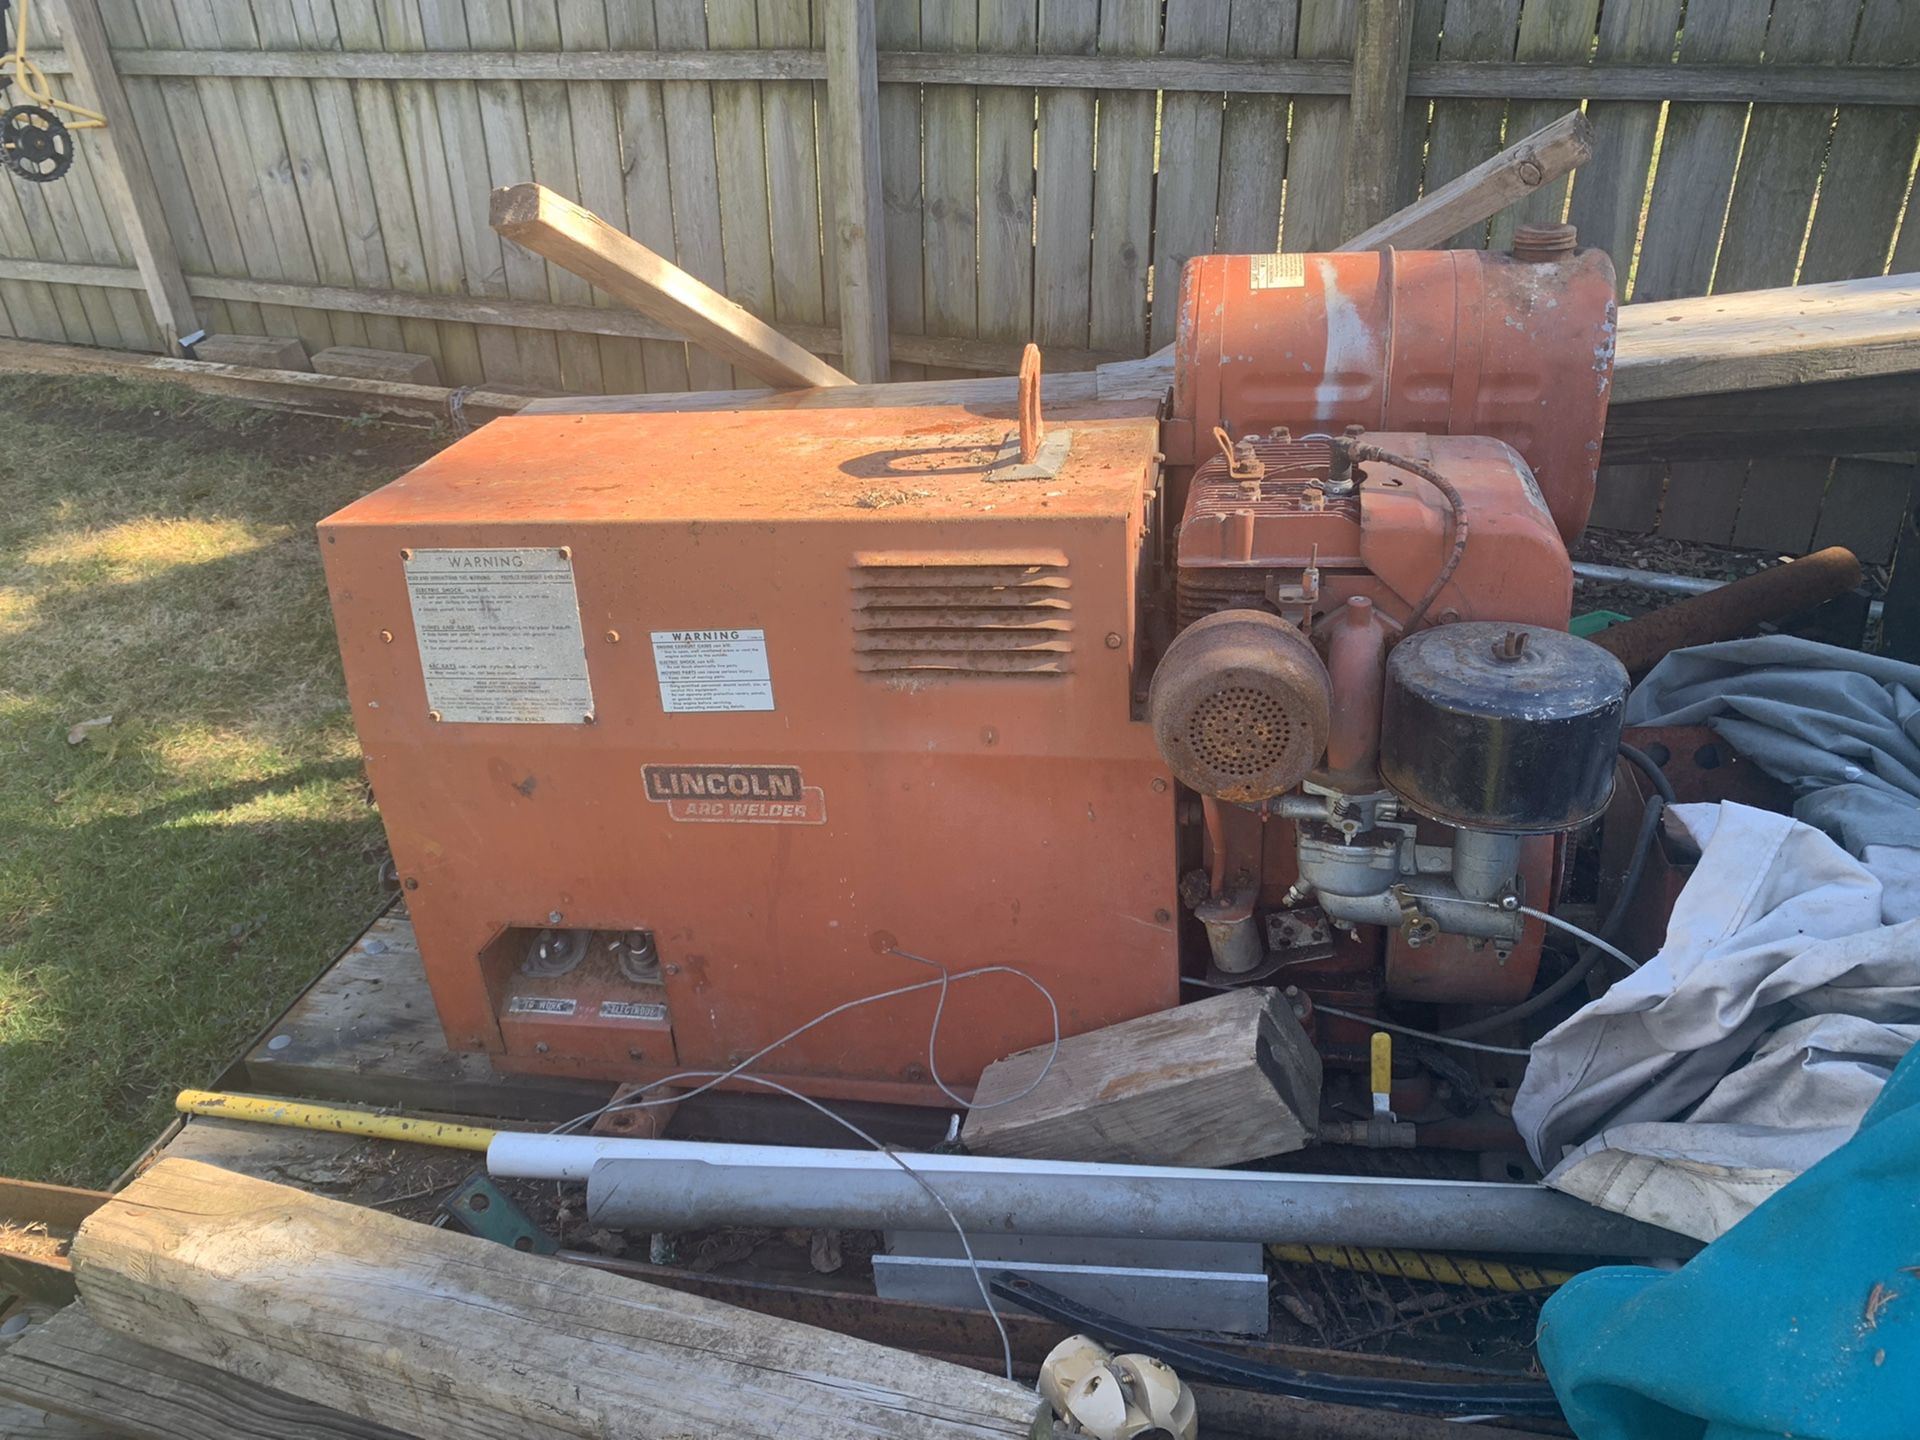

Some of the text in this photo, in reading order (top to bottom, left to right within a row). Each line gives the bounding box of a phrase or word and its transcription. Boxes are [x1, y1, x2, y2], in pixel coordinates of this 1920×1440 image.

[448, 556, 523, 568] WARNING
[672, 631, 739, 641] WARNING
[653, 773, 794, 796] LINCOLN
[685, 803, 806, 817] ARC WELDER
[539, 1001, 562, 1010] WORK
